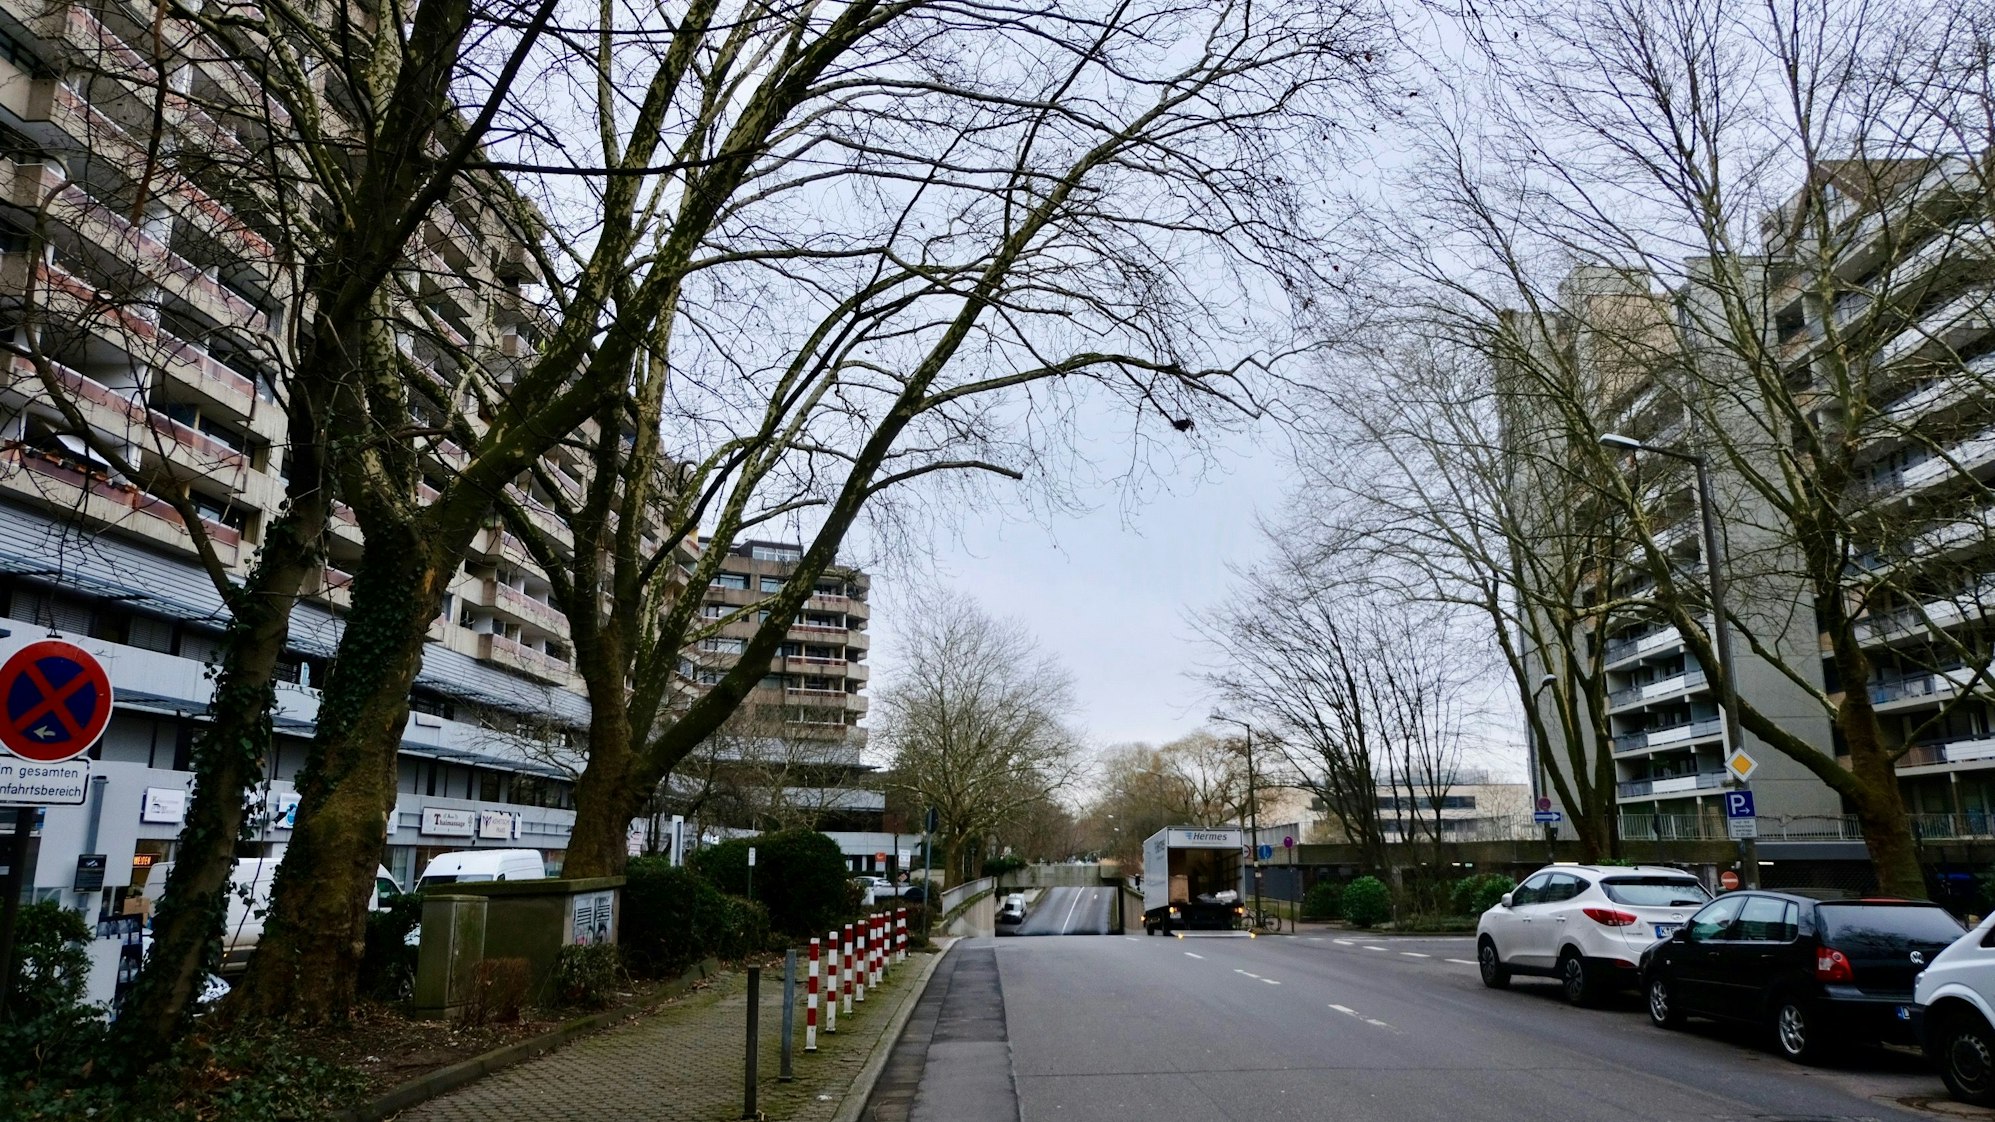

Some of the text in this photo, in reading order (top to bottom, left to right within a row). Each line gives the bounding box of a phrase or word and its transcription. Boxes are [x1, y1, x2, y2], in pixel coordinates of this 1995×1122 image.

[19, 766, 79, 779] gesamten
[1730, 794, 1746, 815] P
[1193, 832, 1228, 841] Hermes
